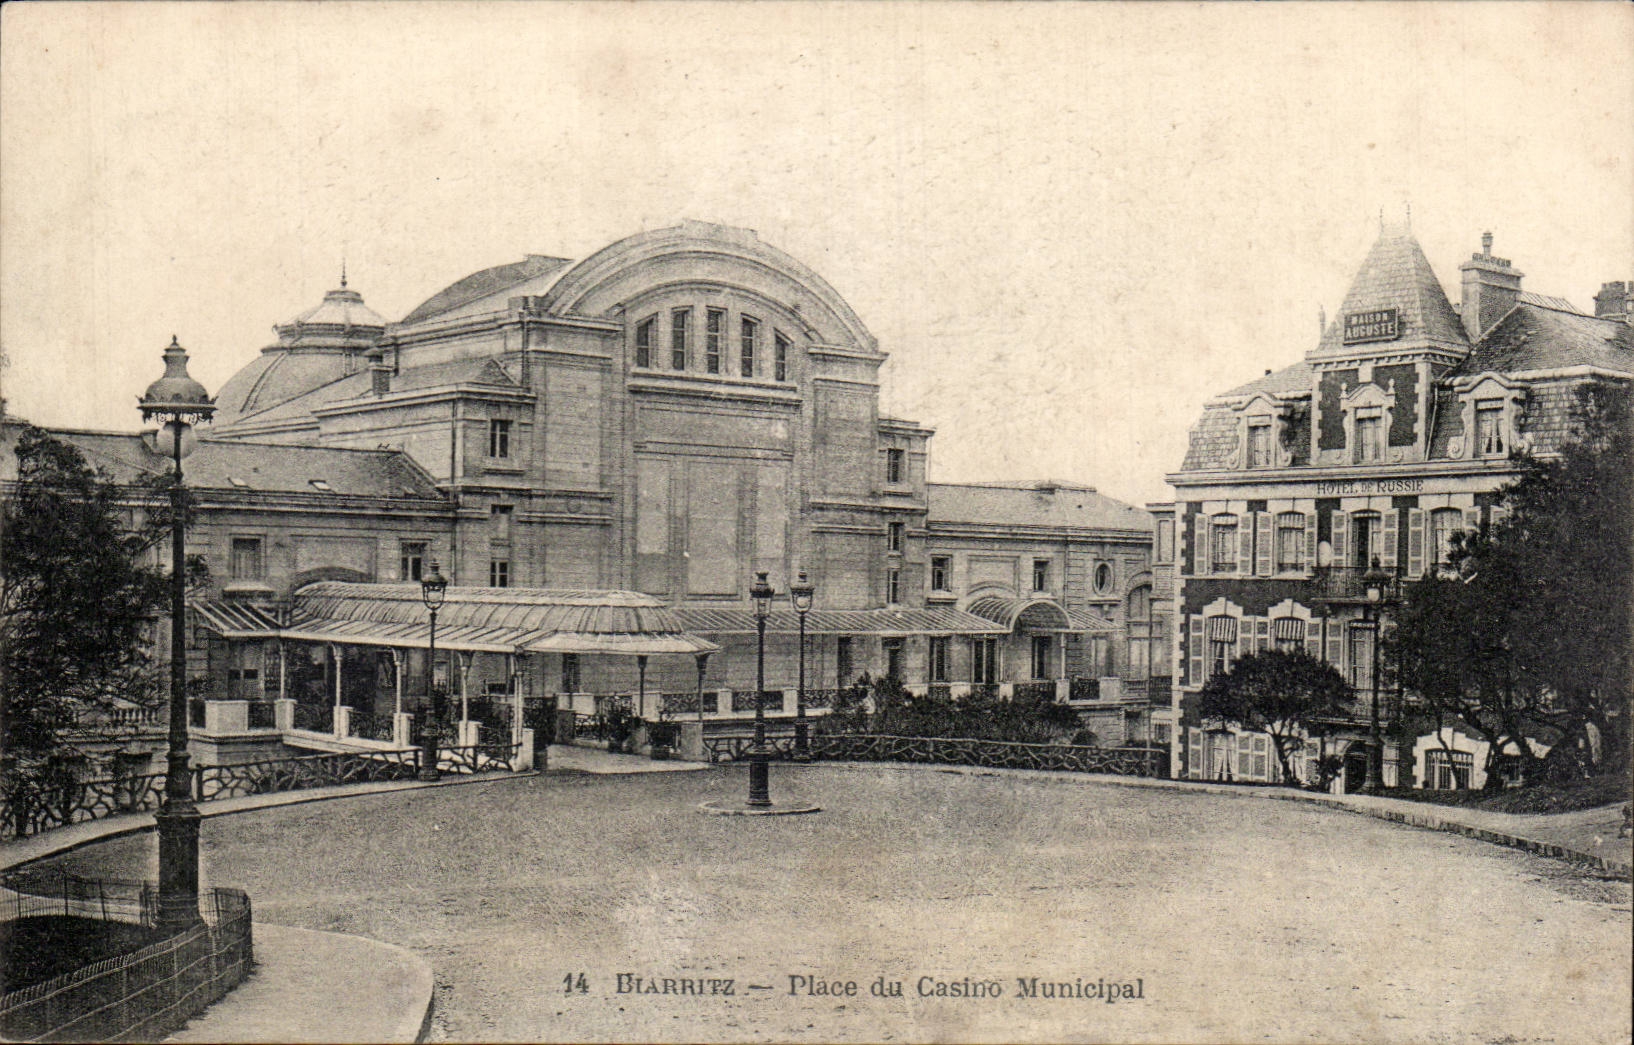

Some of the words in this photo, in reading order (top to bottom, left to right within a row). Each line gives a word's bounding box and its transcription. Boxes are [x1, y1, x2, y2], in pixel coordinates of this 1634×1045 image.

[1351, 312, 1388, 325] MAISON
[1345, 322, 1394, 340] AUGUSTE
[1377, 480, 1424, 493] RUSSIE
